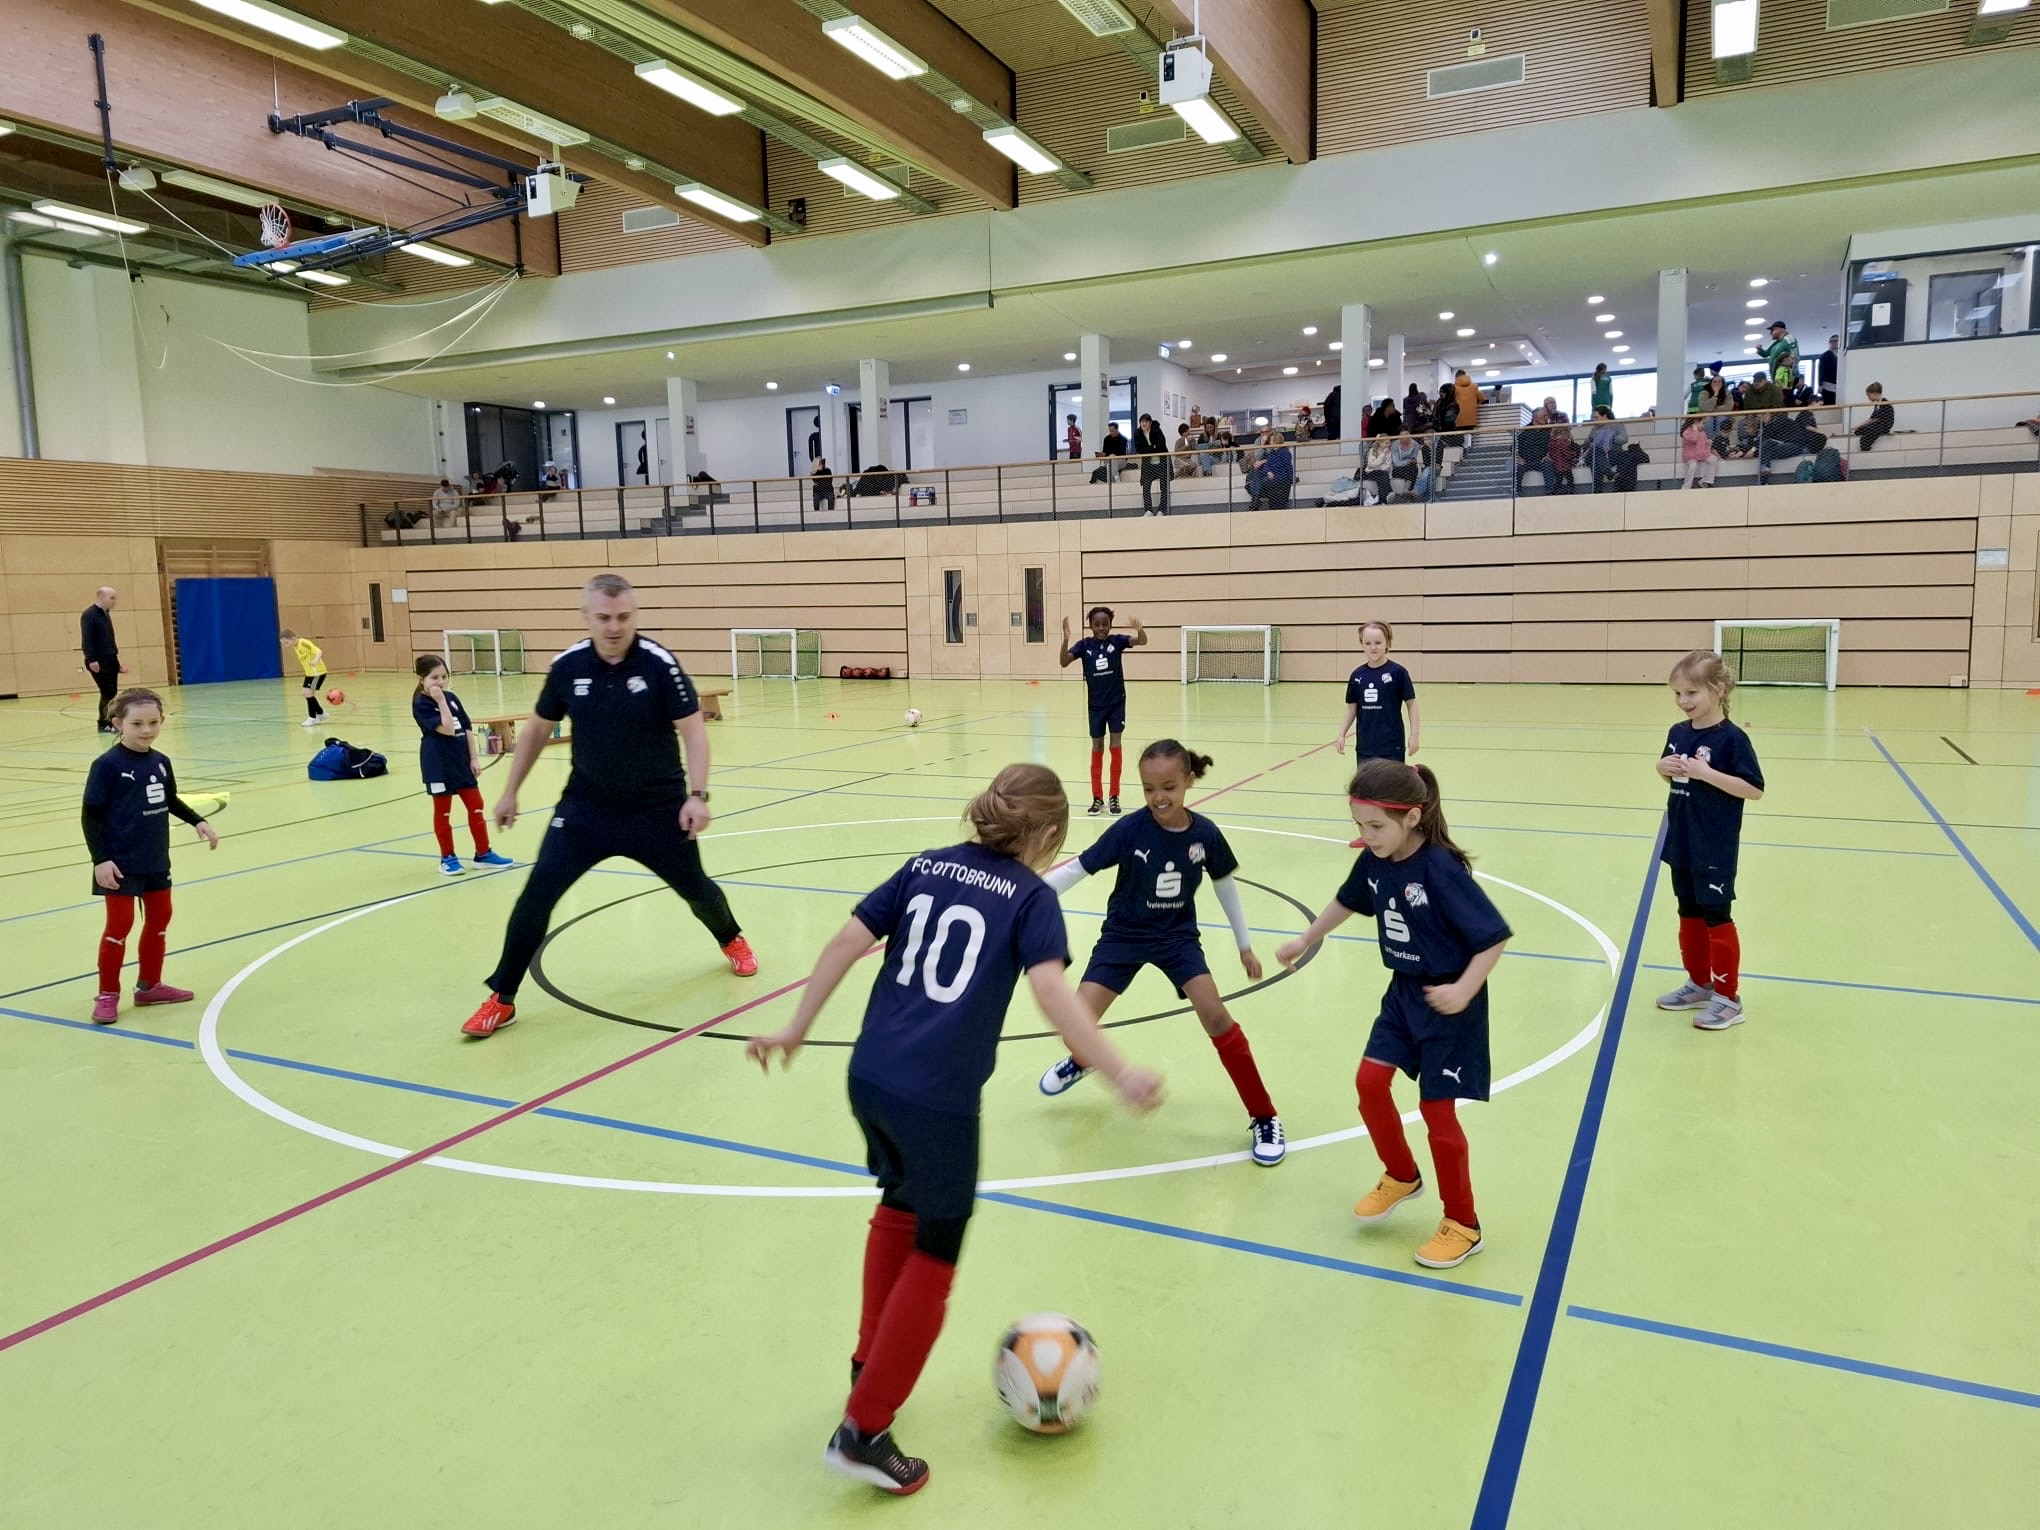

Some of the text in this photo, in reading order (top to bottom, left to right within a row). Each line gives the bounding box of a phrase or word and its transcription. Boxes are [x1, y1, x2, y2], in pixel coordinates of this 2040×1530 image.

[911, 857, 1017, 899] FC OTTOBRUNN
[896, 893, 986, 1004] 10
